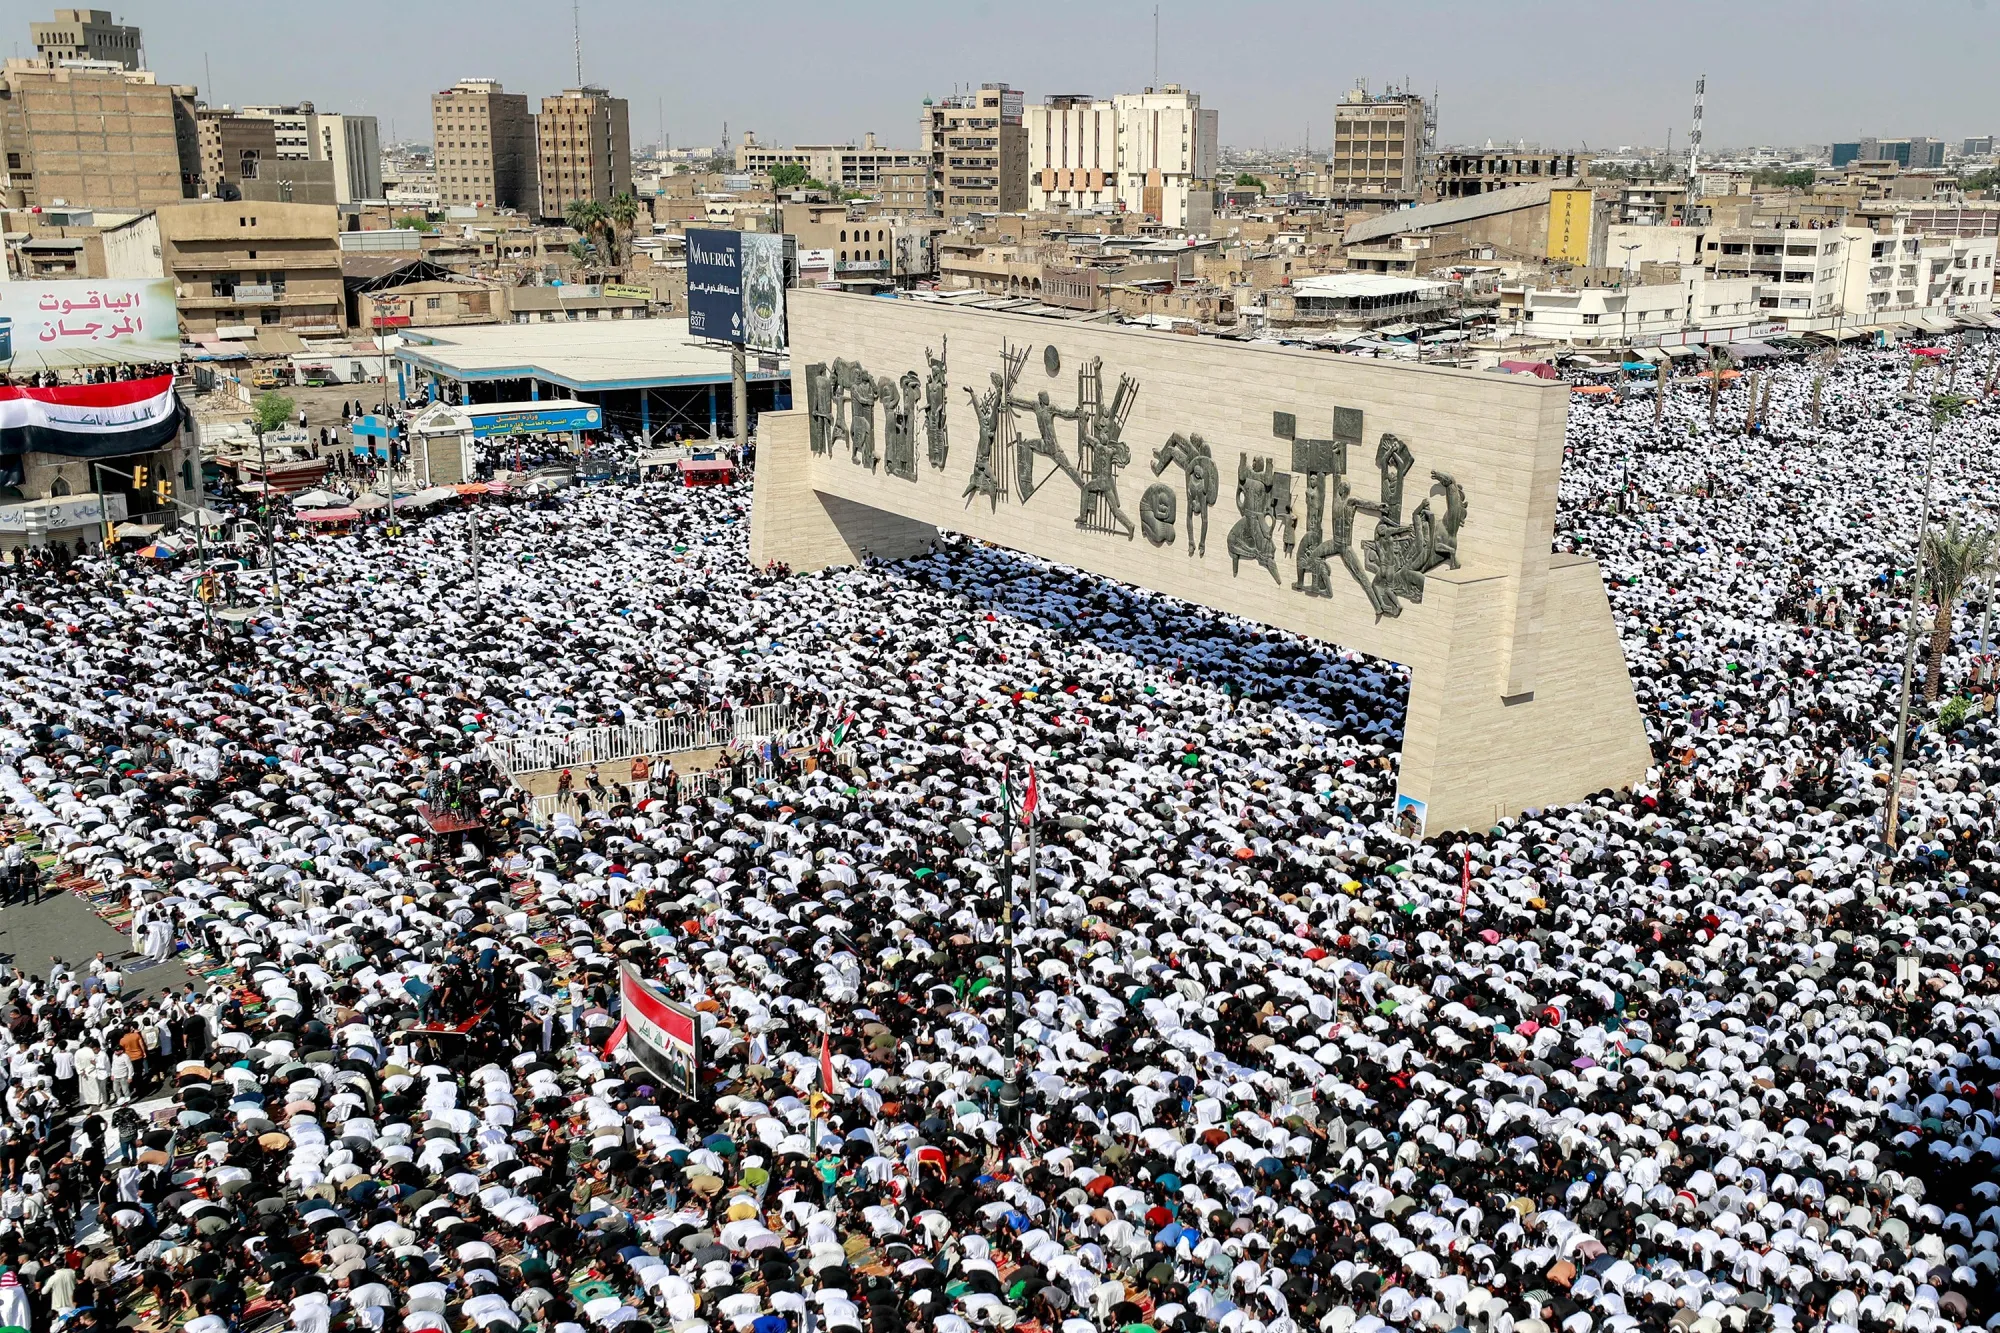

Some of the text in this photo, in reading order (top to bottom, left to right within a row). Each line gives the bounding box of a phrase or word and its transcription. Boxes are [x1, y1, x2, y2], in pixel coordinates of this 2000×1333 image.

[690, 235, 736, 268] MAVERICK
[690, 281, 704, 291] العراق
[39, 290, 140, 315] الياقوت
[690, 315, 706, 327] 6377
[39, 315, 143, 342] المرجان
[266, 433, 277, 443] WC
[293, 431, 307, 443] مرافق
